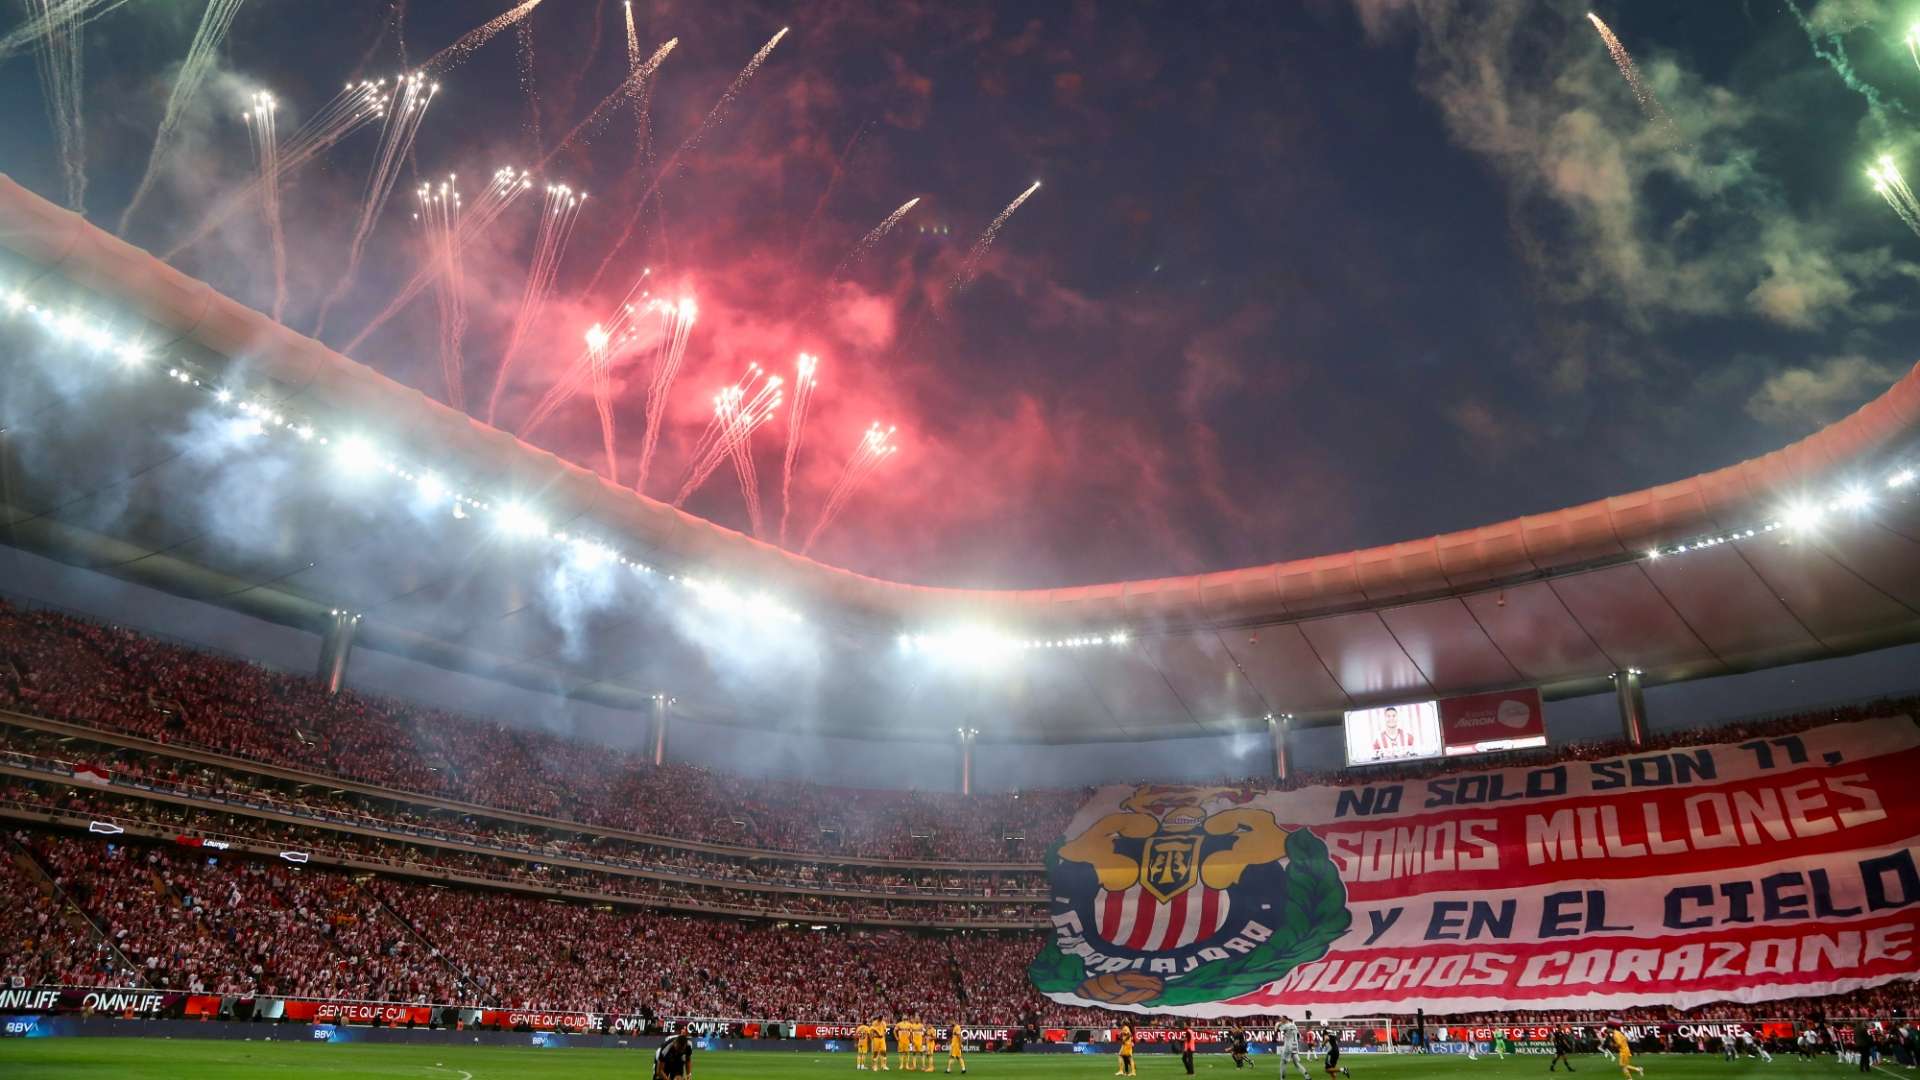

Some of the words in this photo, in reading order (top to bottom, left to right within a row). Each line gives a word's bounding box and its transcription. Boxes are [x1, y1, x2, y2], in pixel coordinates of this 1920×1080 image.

[1335, 785, 1404, 817] NO
[1425, 765, 1568, 808] SOLO
[1590, 749, 1717, 790] SON
[1325, 818, 1501, 882] SOMOS
[1526, 772, 1887, 867] MILLONES
[203, 838, 230, 850] Lounge
[1363, 906, 1405, 945] Y
[1424, 899, 1517, 940] EN
[1538, 889, 1634, 938] EL
[1662, 847, 1920, 930] CIELO
[1266, 951, 1517, 996] MUCHOS
[318, 1005, 357, 1018] GENTE
[509, 1013, 541, 1026] GENTE
[6, 1022, 39, 1033] BBVA
[816, 1027, 840, 1036] GENTE
[1476, 1028, 1510, 1039] GETE
[314, 1029, 337, 1039] BBVA
[961, 1029, 1008, 1041] OMNILIFE
[1136, 1031, 1166, 1040] GENTE
